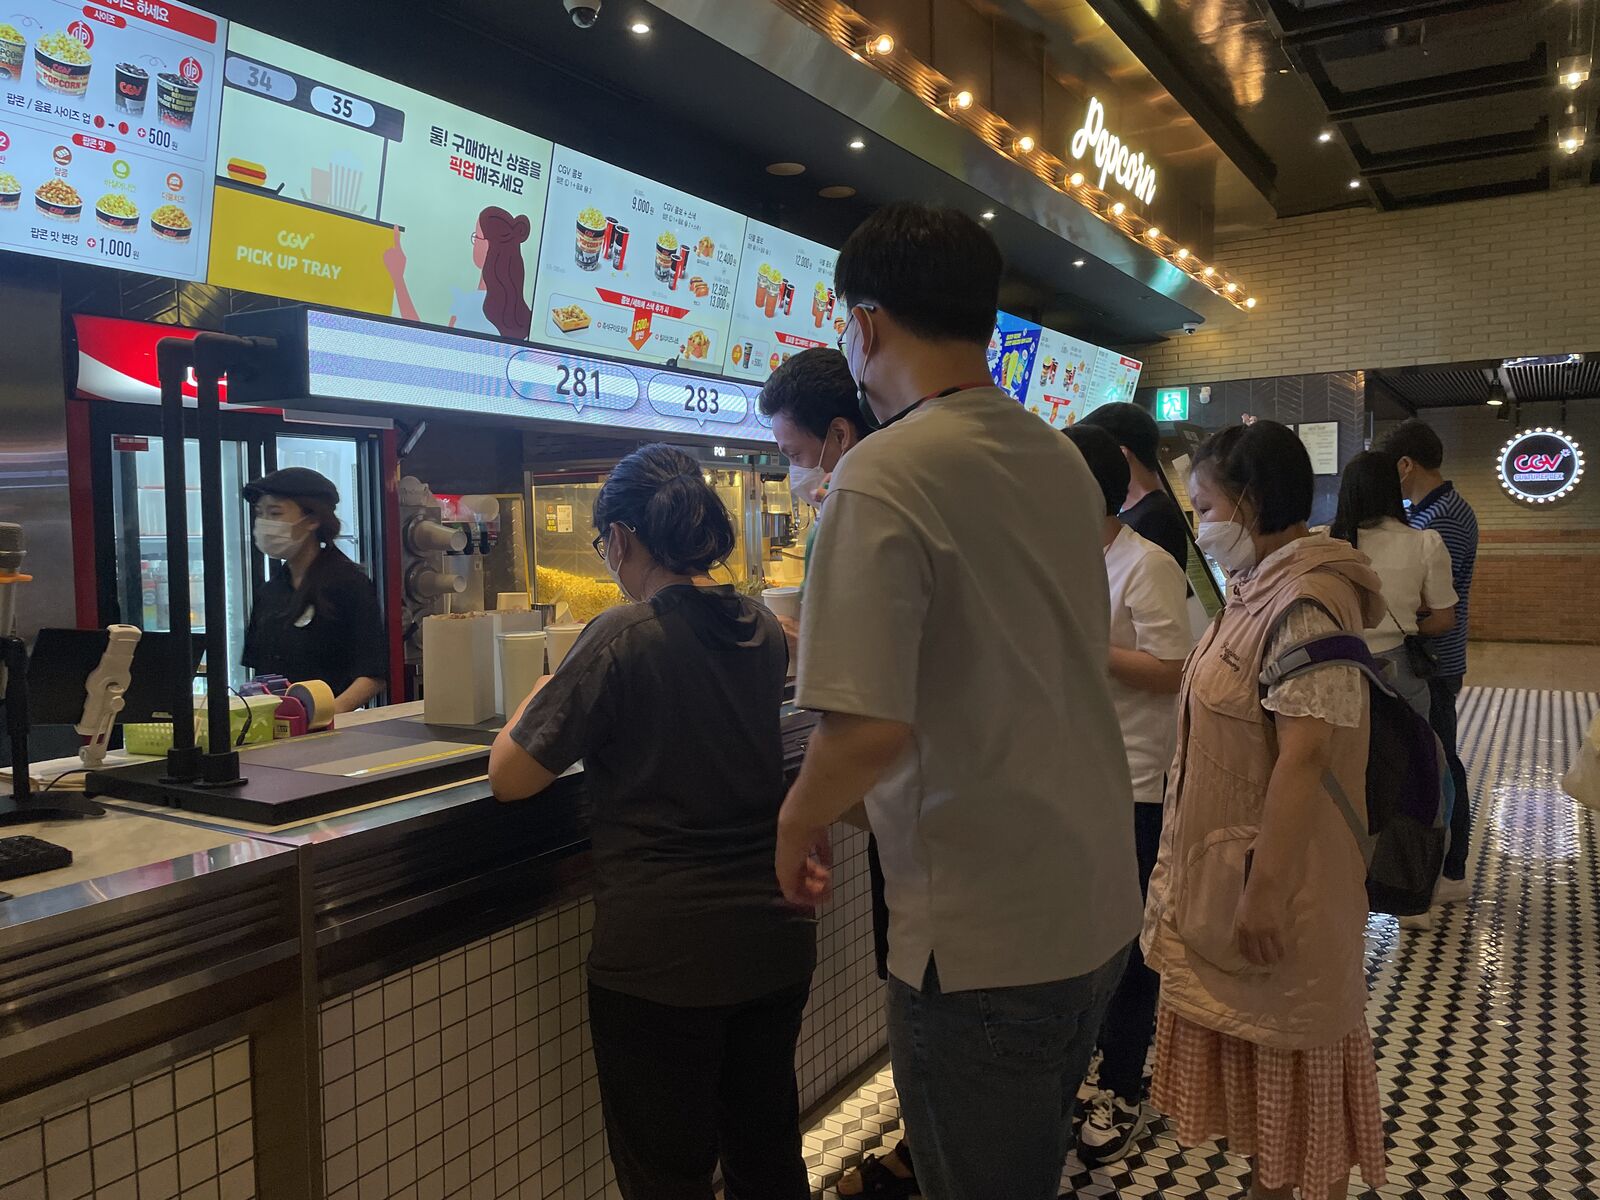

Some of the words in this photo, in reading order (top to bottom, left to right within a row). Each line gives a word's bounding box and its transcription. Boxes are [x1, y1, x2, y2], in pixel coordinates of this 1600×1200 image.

[93, 10, 116, 24] 사이즈
[137, 0, 170, 23] 하세요
[43, 72, 81, 89] POPCORN
[247, 65, 273, 92] 34
[7, 92, 25, 107] 팝콘
[34, 100, 52, 114] 음료
[54, 106, 80, 121] 사이즈
[82, 112, 91, 124] 업
[331, 94, 354, 119] 35
[82, 135, 97, 149] 팝콘
[430, 125, 448, 147] 둘!
[452, 133, 503, 166] 구매하신
[506, 152, 542, 180] 상품을
[1071, 96, 1157, 205] Popcorn
[449, 155, 525, 195] 픽업해주세요
[558, 164, 571, 175] CGV
[663, 202, 674, 212] CGV
[30, 227, 48, 240] 팝콘
[50, 231, 59, 242] 맛
[62, 232, 78, 246] 변경
[236, 245, 272, 267] PICK
[277, 252, 298, 271] UP
[301, 258, 342, 280] TRAY
[556, 364, 602, 399] 281
[684, 384, 720, 414] 283
[1513, 451, 1564, 472] CGV
